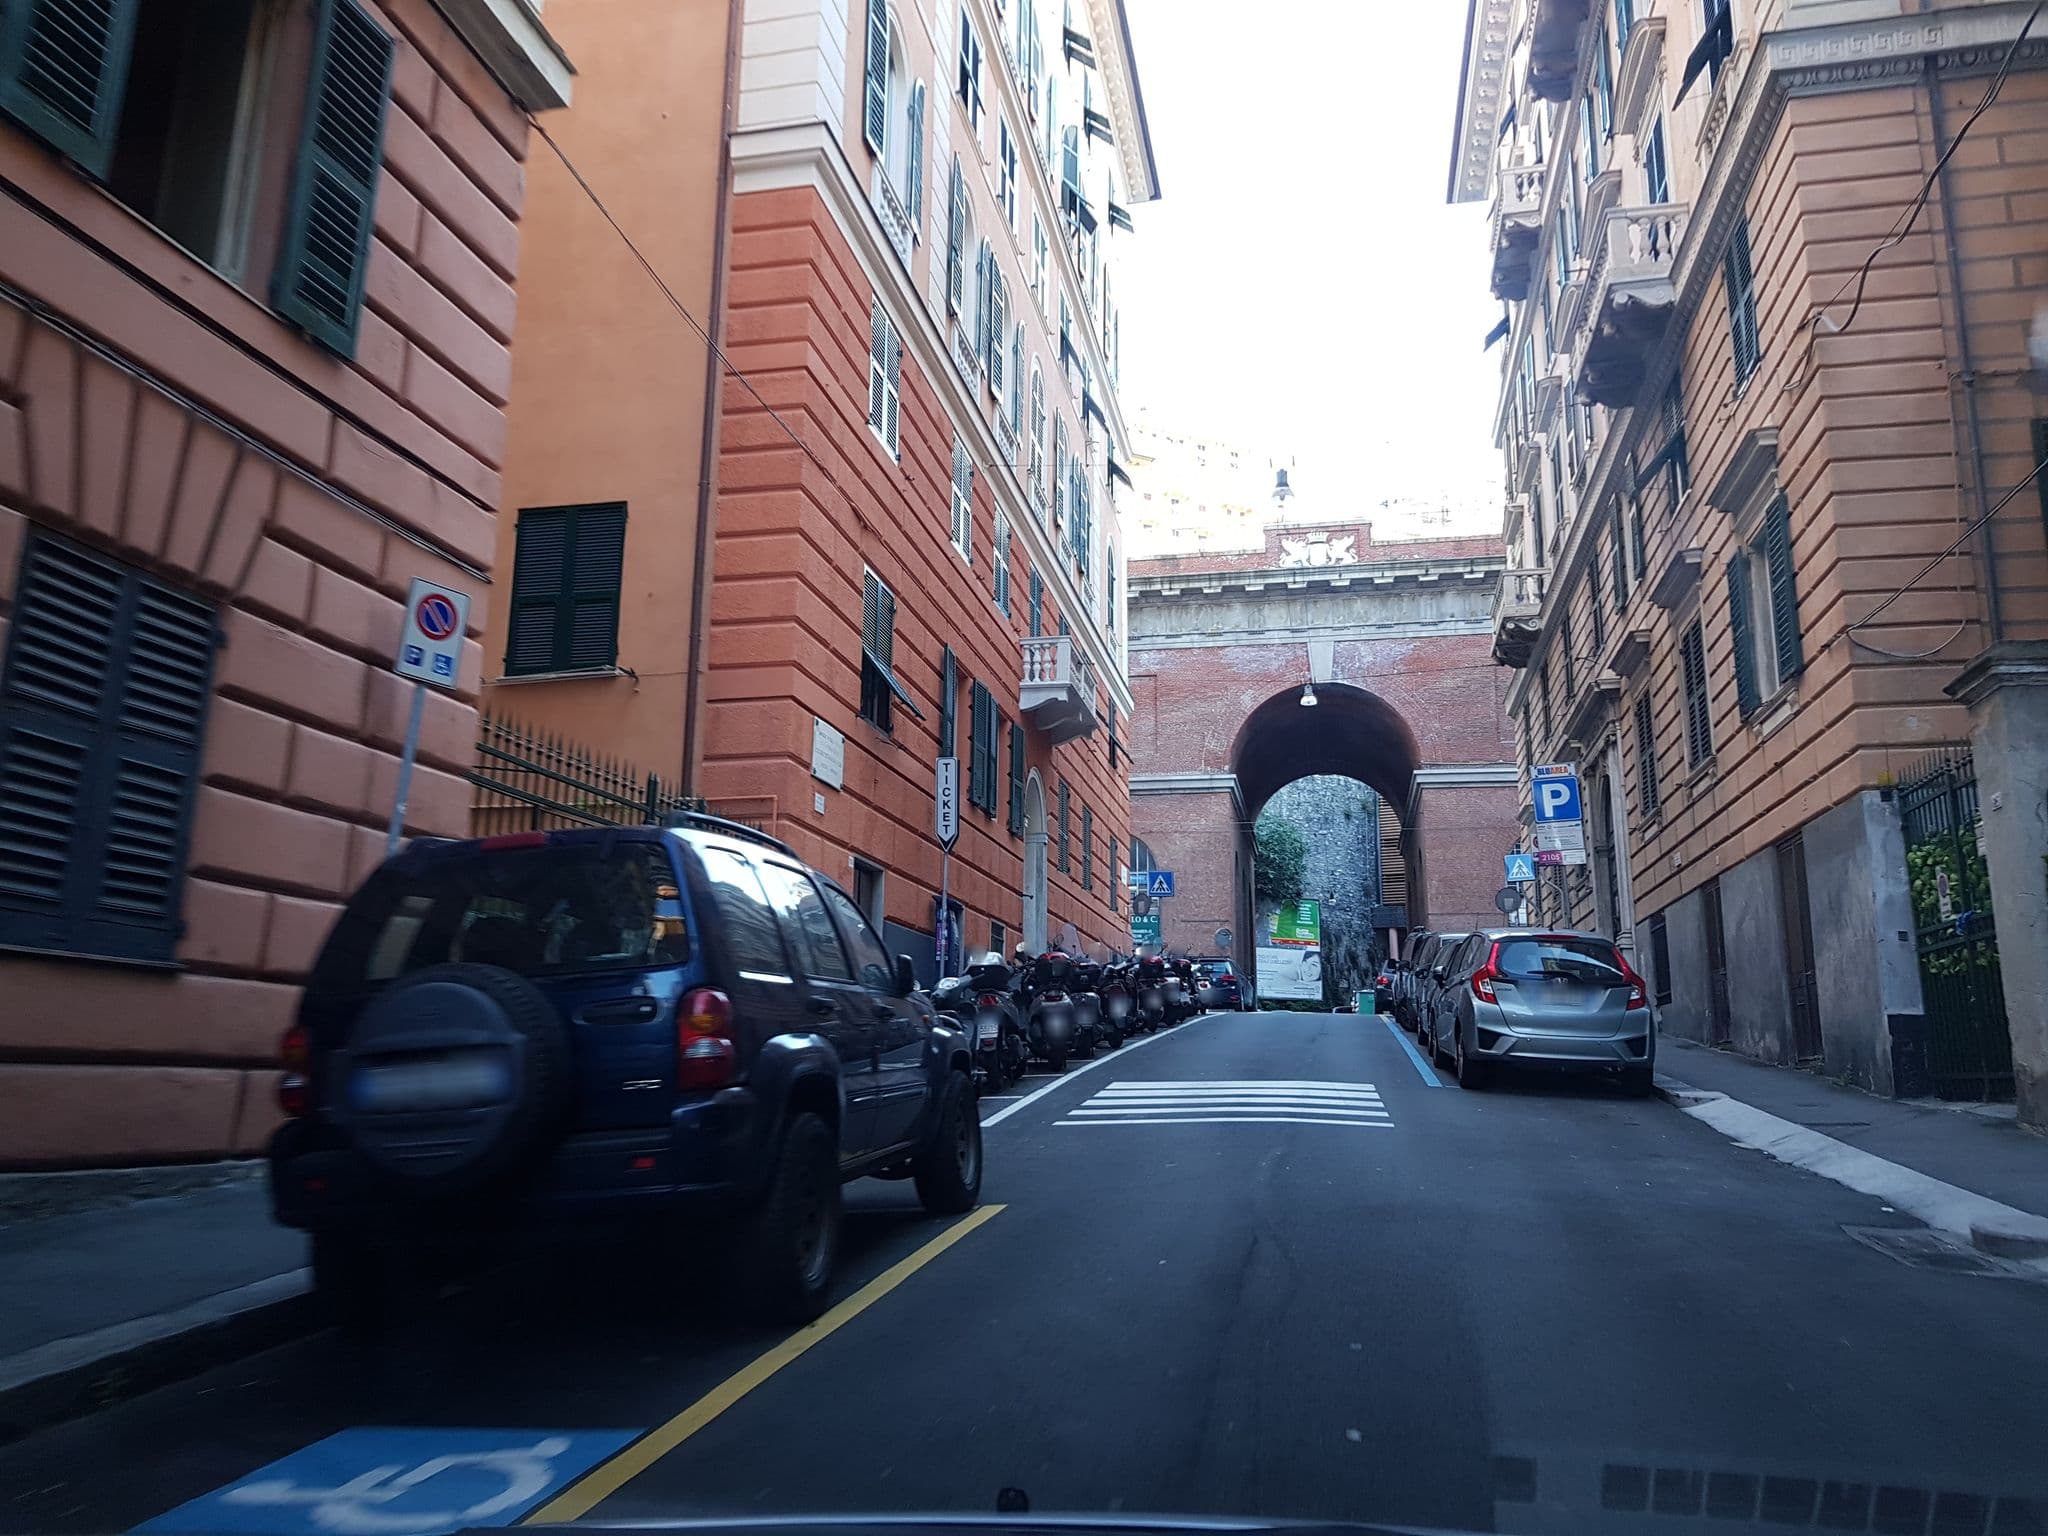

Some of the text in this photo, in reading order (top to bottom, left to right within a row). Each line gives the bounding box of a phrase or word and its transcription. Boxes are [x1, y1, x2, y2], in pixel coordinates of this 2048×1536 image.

[942, 762, 951, 835] TICKET
[1541, 783, 1571, 818] P
[1541, 853, 1561, 861] 2105
